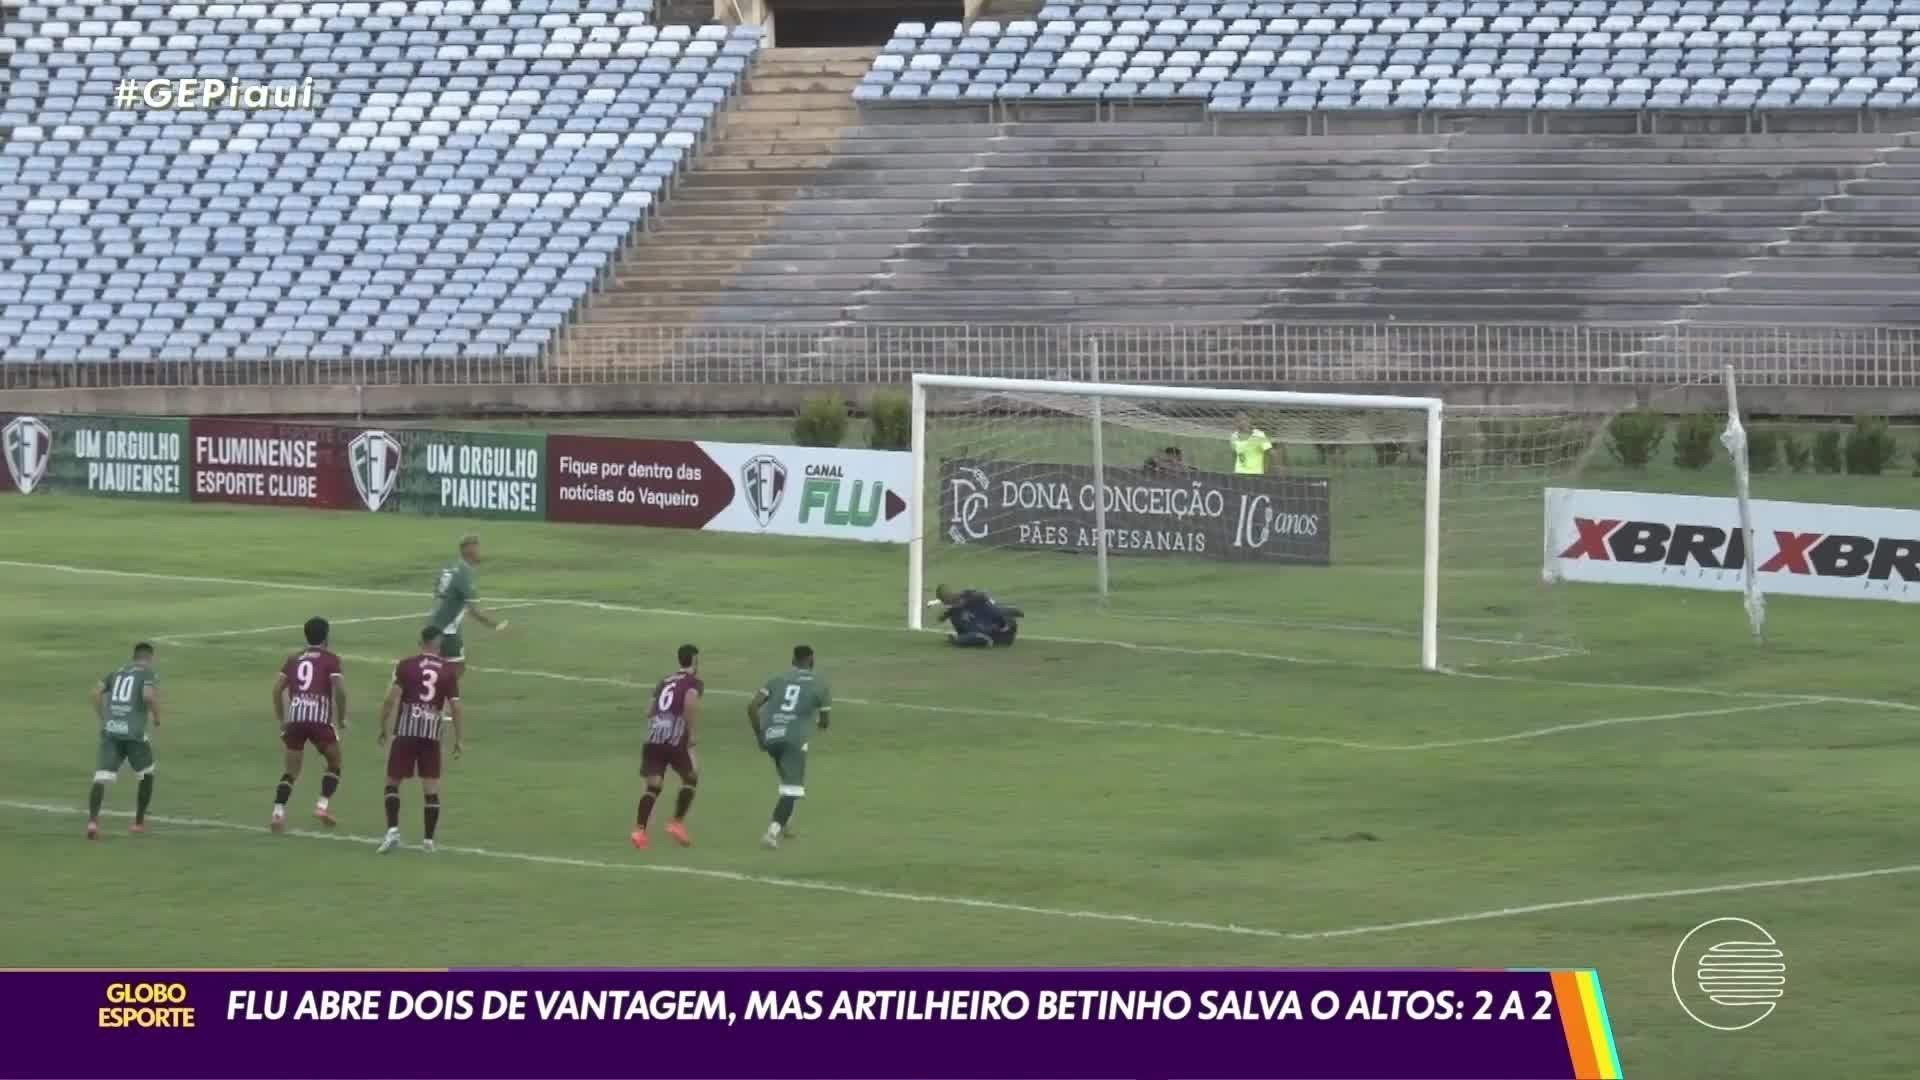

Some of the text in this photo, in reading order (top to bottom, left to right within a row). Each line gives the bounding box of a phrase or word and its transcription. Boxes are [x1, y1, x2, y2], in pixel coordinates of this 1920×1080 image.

[75, 430, 180, 461] UM ORGULHO
[196, 436, 318, 468] FLUMINENSE
[426, 444, 538, 479] UM ORGULHO
[559, 456, 702, 481] Fique por dentro das
[804, 464, 844, 478] CANAL
[88, 462, 180, 493] PIAUIENSE!
[196, 472, 318, 498] ESPORTE CLUBE
[441, 478, 538, 512] PIAUIENSE!
[559, 484, 699, 508] notícias do Vaqueiro
[798, 477, 884, 527] FLU
[1002, 480, 1224, 520] DONA CONCEIÇÃO
[1019, 520, 1068, 545] PÃES
[1274, 512, 1319, 536] anos
[111, 675, 135, 702] 10
[297, 660, 314, 691] 9
[419, 669, 439, 701] 3
[658, 682, 677, 711] 6
[780, 684, 801, 711] 9
